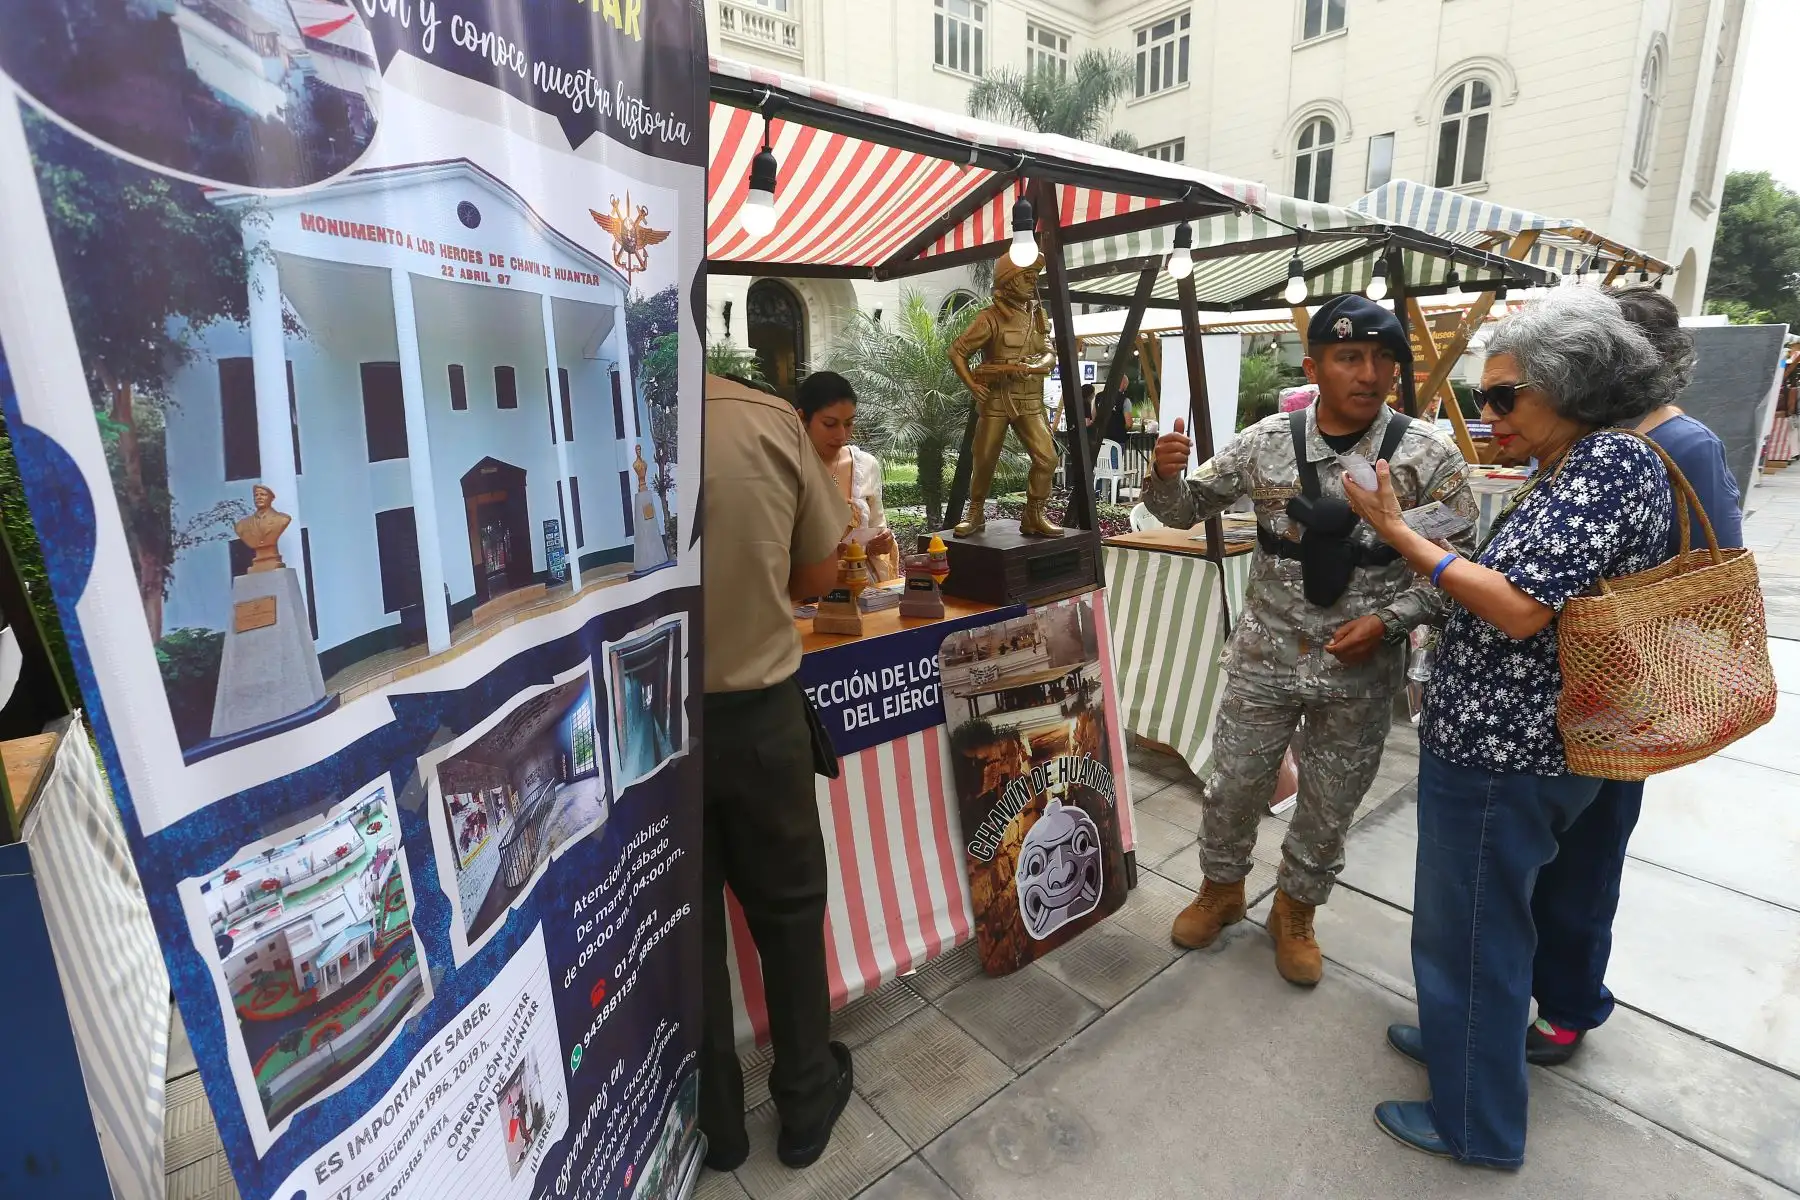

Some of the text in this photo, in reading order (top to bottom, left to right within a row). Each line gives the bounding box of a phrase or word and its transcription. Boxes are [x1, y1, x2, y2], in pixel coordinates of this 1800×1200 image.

[451, 15, 527, 78] conoce
[533, 61, 613, 115] nuestra
[616, 81, 691, 146] historia
[300, 212, 600, 287] MONUMENTO A LOS HEROES DE CHAVIN DE HUANTAR
[441, 264, 455, 278] 22
[460, 270, 491, 284] ABRIL
[880, 663, 906, 691] DE
[908, 654, 940, 683] LOS
[842, 701, 880, 732] DEL
[967, 751, 1116, 862] CHAVÍN DE HUÁNTAR
[573, 862, 622, 919] Atención
[627, 815, 669, 860] público:
[576, 919, 593, 943] De
[596, 878, 627, 924] martes
[631, 838, 669, 875] sábado
[564, 965, 577, 989] de
[578, 925, 614, 968] 09:00
[632, 862, 665, 897] 04:00
[666, 847, 685, 872] pm.
[583, 969, 637, 1048] 943881139
[614, 957, 627, 979] 01
[314, 1002, 491, 1186] ES IMPORTANTE SABER:
[446, 992, 530, 1149] OPERACIÓN MILITAR
[456, 1000, 539, 1162] CHAVÍN DE HUÁNTAR
[610, 1058, 625, 1087] en
[356, 1171, 375, 1192] de
[377, 1109, 425, 1173] diciembre
[424, 1078, 452, 1111] 1996,
[452, 1047, 479, 1082] 20:19
[479, 1039, 490, 1054] h.
[381, 1113, 450, 1200] roristas MRTA
[581, 1130, 606, 1187] Pastor
[591, 1130, 617, 1189] UNION
[618, 1104, 630, 1134] del
[611, 1125, 632, 1172] llegar
[633, 1116, 639, 1128] a
[639, 1101, 647, 1118] la
